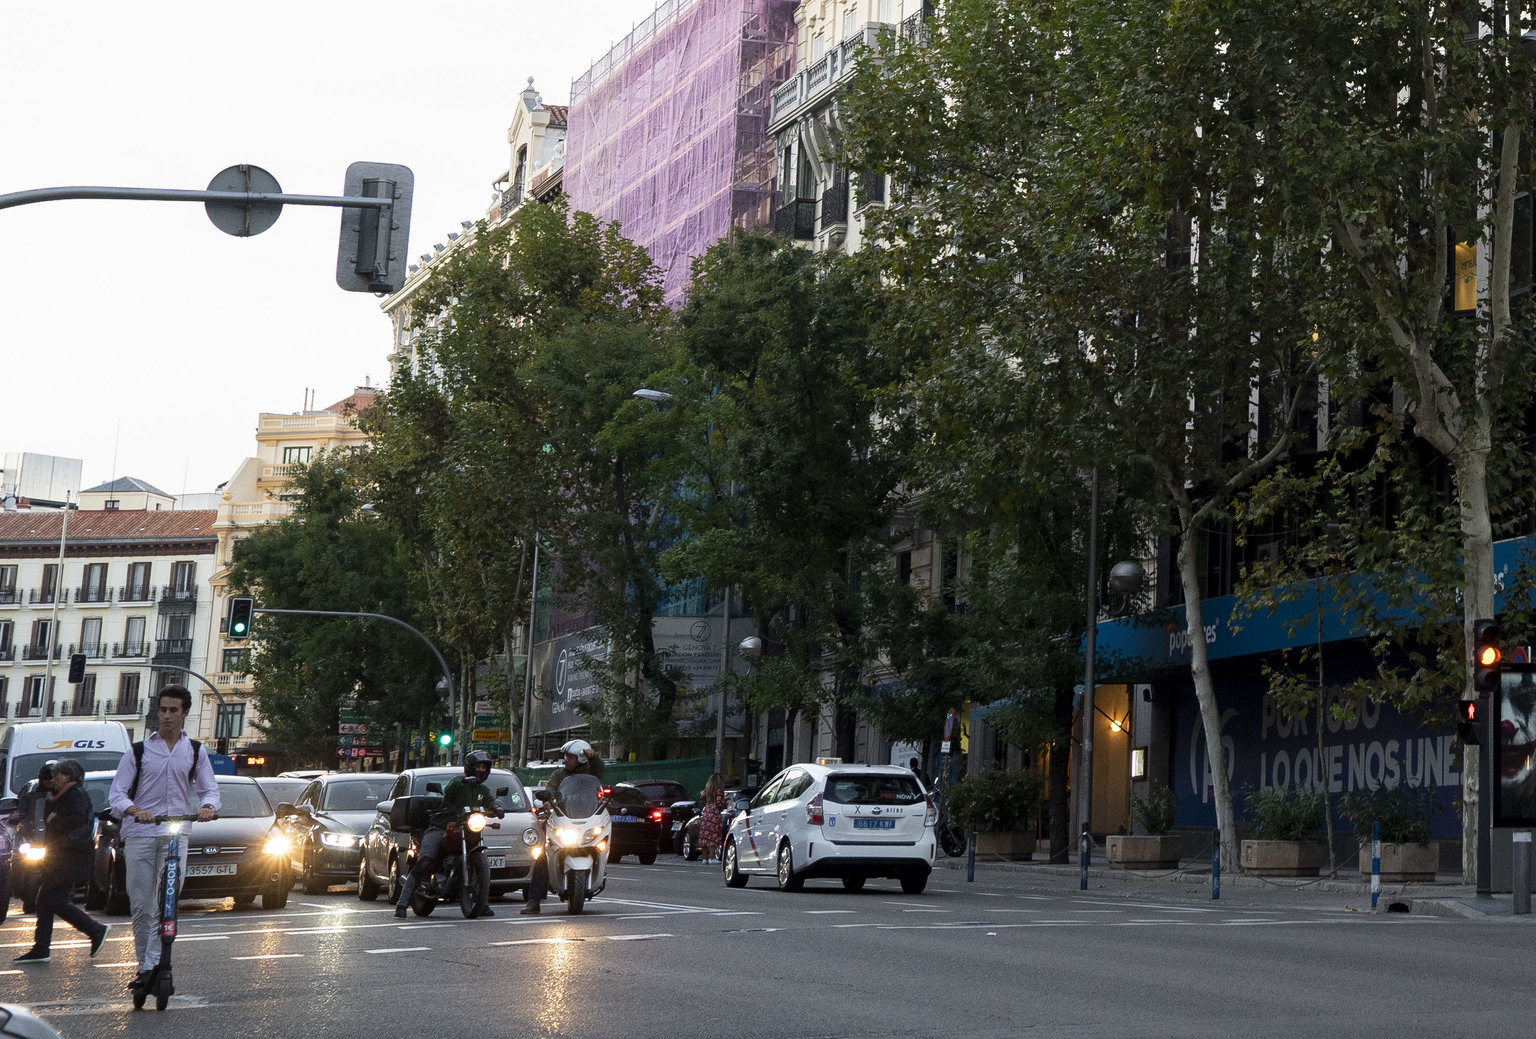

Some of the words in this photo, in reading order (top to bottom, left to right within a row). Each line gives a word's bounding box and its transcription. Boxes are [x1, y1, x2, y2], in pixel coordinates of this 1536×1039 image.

[1169, 624, 1217, 656] popues
[74, 740, 105, 748] GLS
[1294, 744, 1343, 794] QUE
[1350, 739, 1400, 792] NOS
[166, 862, 177, 896] MOVO
[189, 866, 213, 875] 3557
[217, 865, 234, 874] GTL
